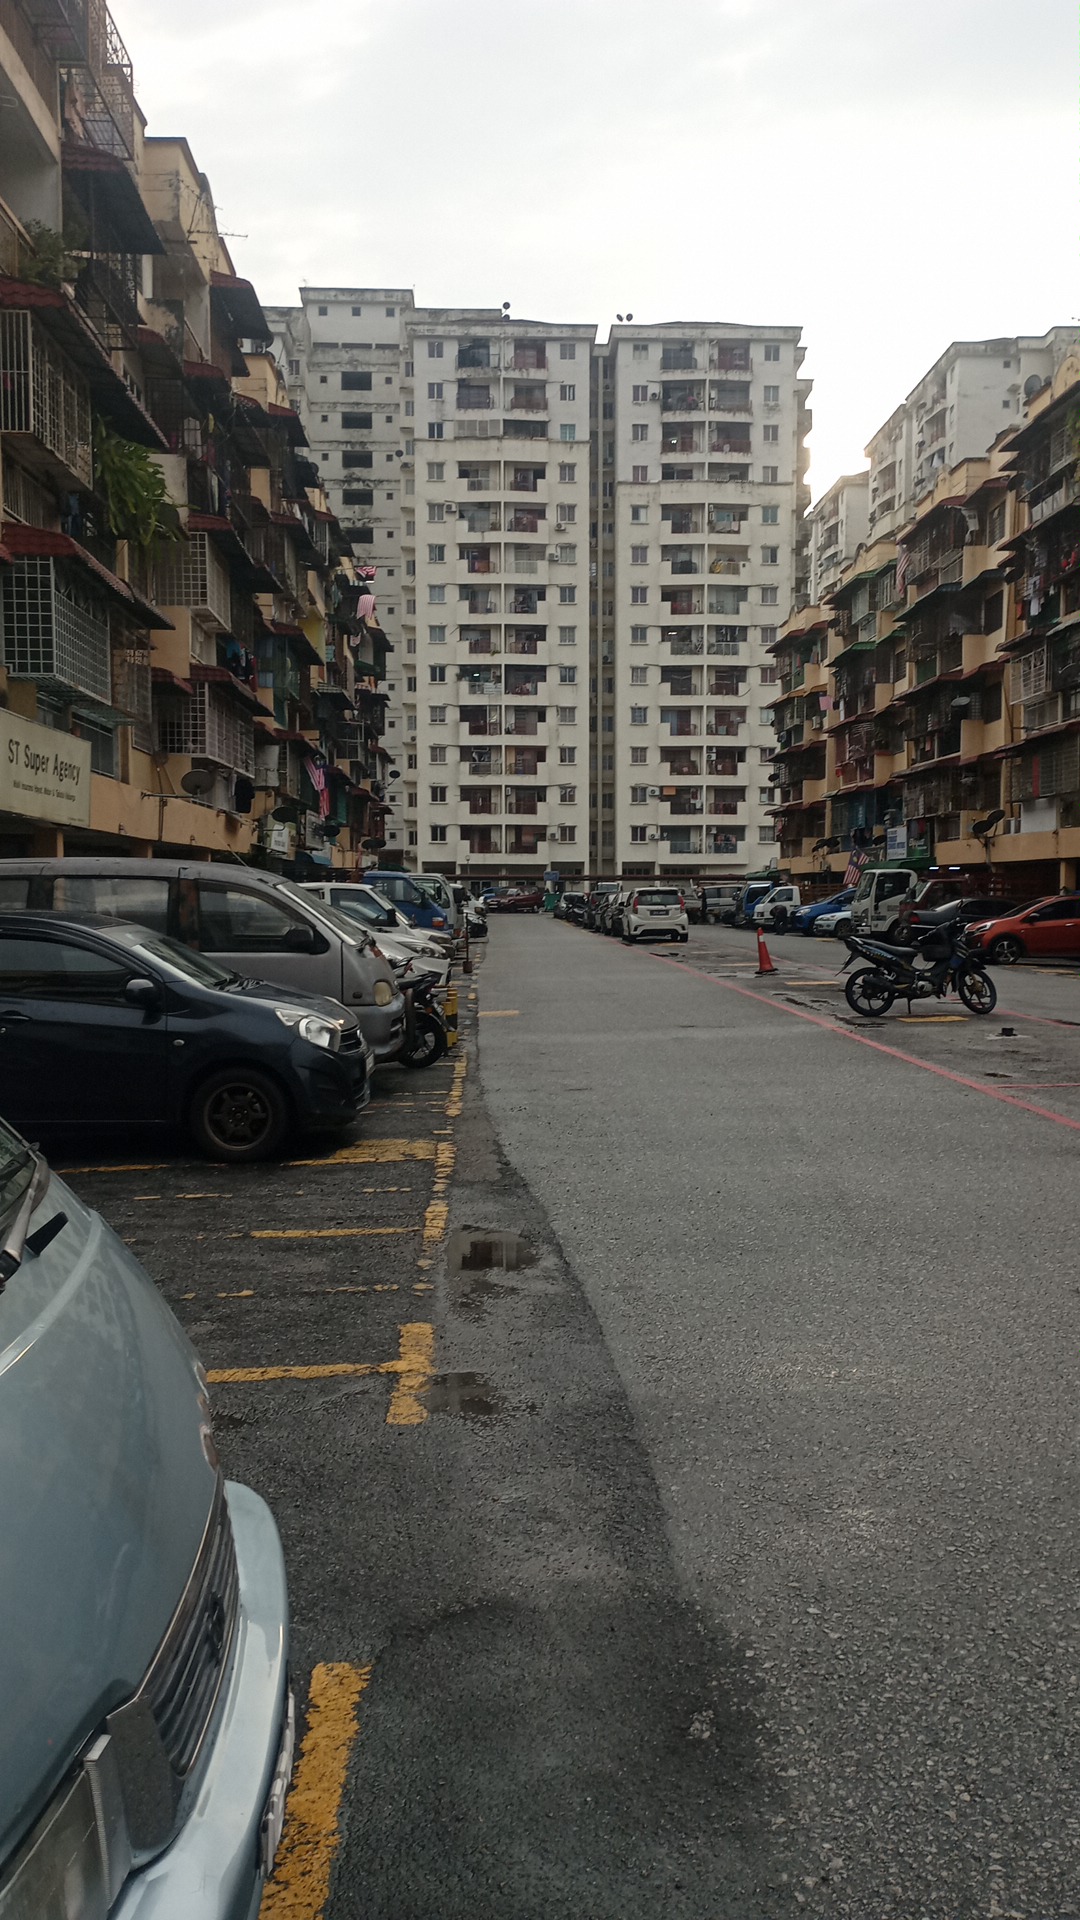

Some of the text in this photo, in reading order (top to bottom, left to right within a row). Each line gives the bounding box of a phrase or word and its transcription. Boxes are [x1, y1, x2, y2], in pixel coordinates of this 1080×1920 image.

[8, 739, 80, 786] ST Super Agency
